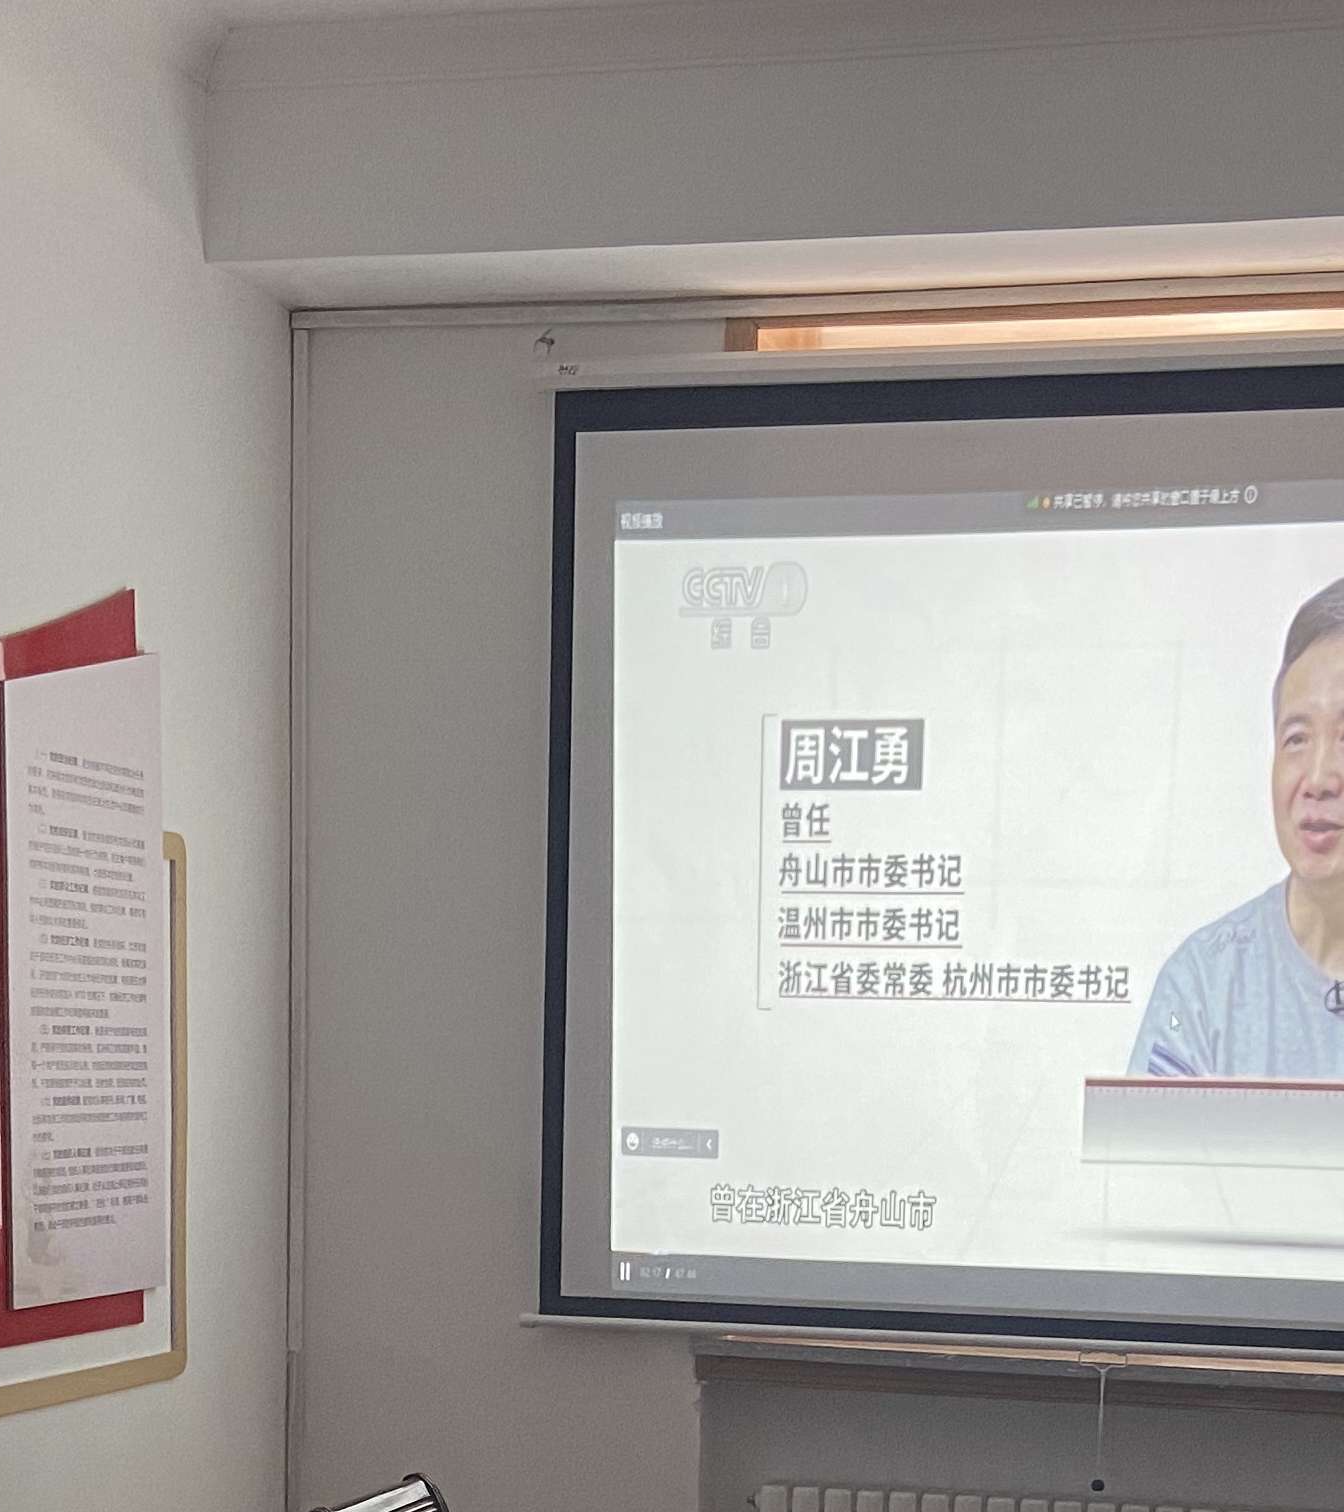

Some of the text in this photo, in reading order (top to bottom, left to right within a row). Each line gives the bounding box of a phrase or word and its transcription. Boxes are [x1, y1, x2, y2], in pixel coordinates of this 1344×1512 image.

[784, 726, 909, 785] 周江勇
[782, 802, 831, 838] 曾任
[778, 853, 963, 888] 舟山市市委书记
[777, 906, 961, 942] 温州市市委书记
[778, 960, 1131, 999] 浙江省委常委 杭州市市委书记
[709, 1183, 937, 1231] 曾在浙江省舟山市
